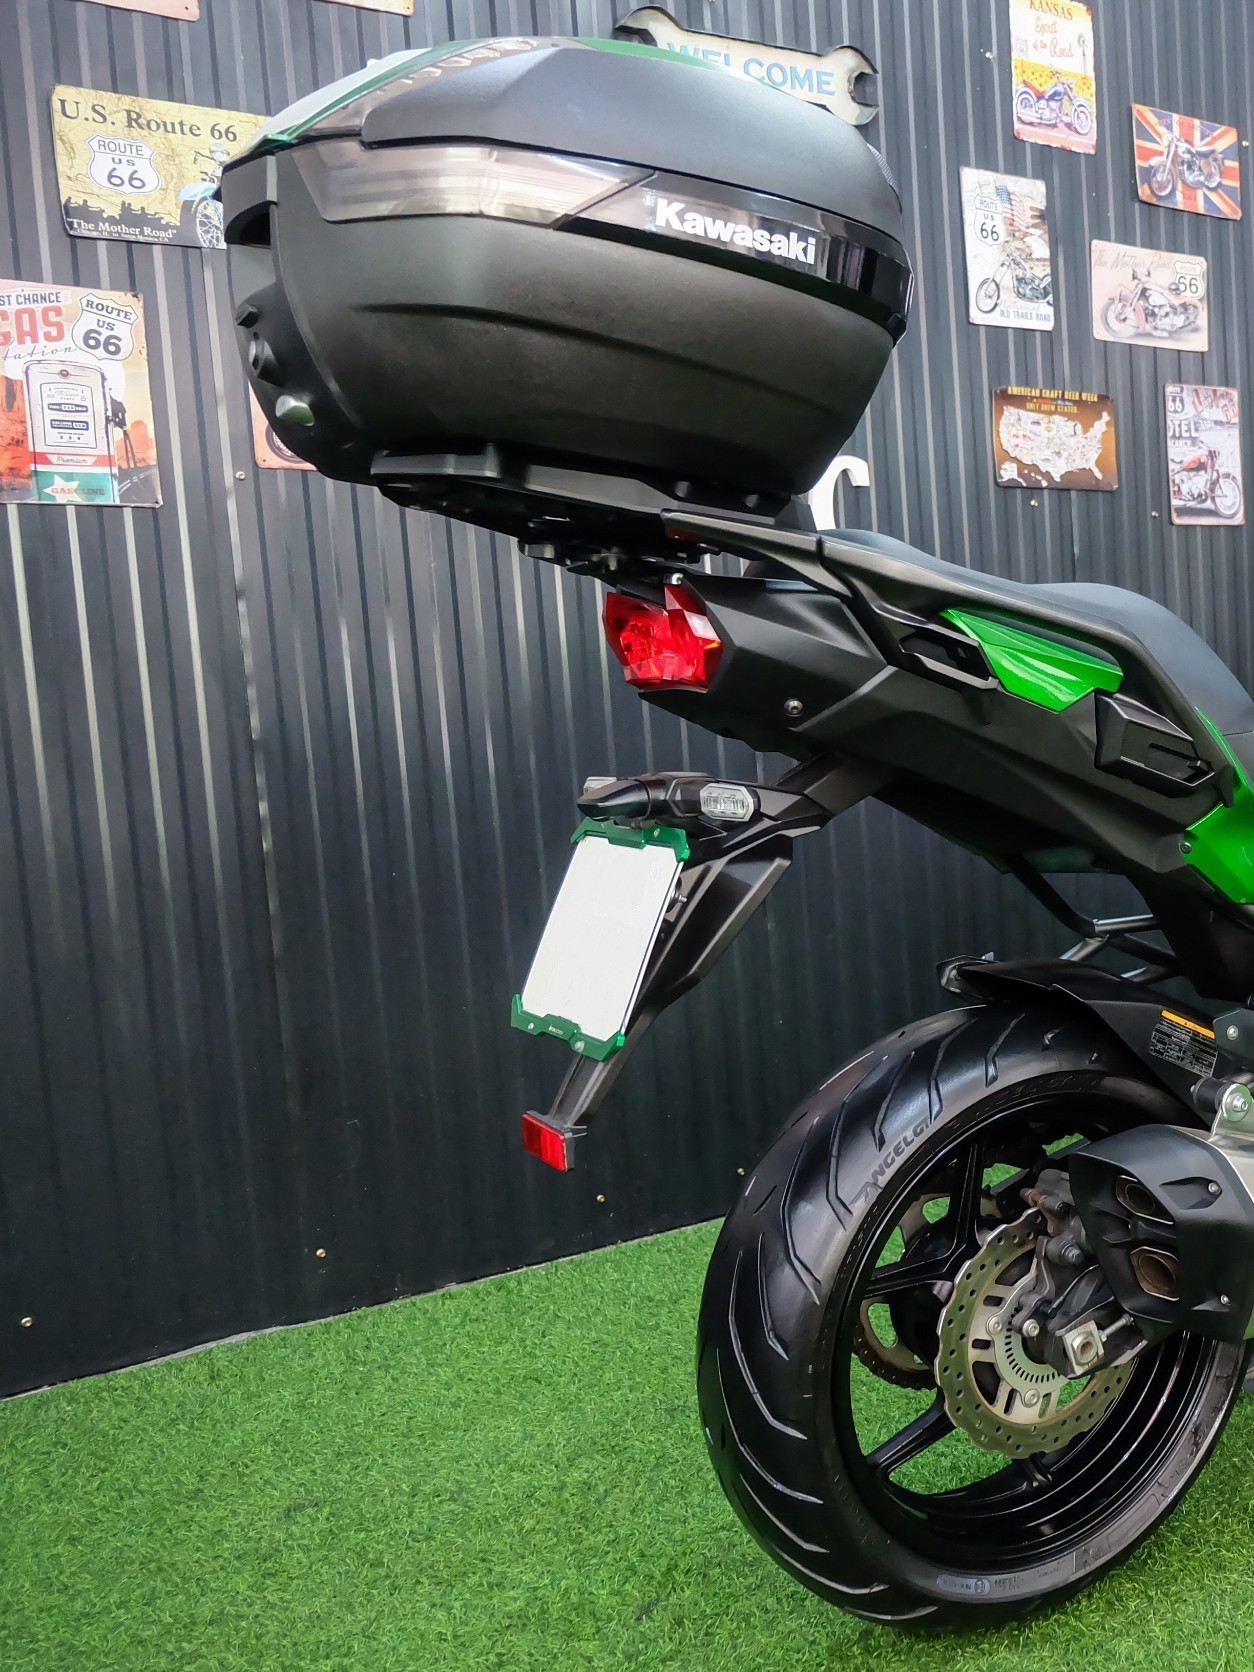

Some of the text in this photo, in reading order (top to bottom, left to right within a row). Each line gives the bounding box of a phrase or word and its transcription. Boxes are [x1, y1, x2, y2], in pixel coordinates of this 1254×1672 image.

[1030, 0, 1073, 20] KANSAS
[58, 98, 238, 143] U.S. Route 66
[98, 139, 144, 157] ROUTE
[107, 167, 146, 190] 66
[980, 199, 999, 211] ROUTE
[98, 221, 140, 235] Mother
[655, 198, 816, 265] Kawasaki
[980, 221, 999, 241] 66
[1178, 275, 1199, 294] 66
[15, 291, 62, 306] CHANCE
[85, 299, 133, 321] ROUTE
[96, 318, 116, 331] US
[82, 328, 123, 356] 66
[1007, 386, 1040, 397] AMERICAN
[1041, 388, 1062, 398] CRAFT
[1064, 391, 1080, 400] BEER
[1081, 392, 1098, 402] WEEK
[1167, 395, 1184, 413] 66
[56, 455, 88, 465] Premium
[51, 486, 105, 496] GASOLINE
